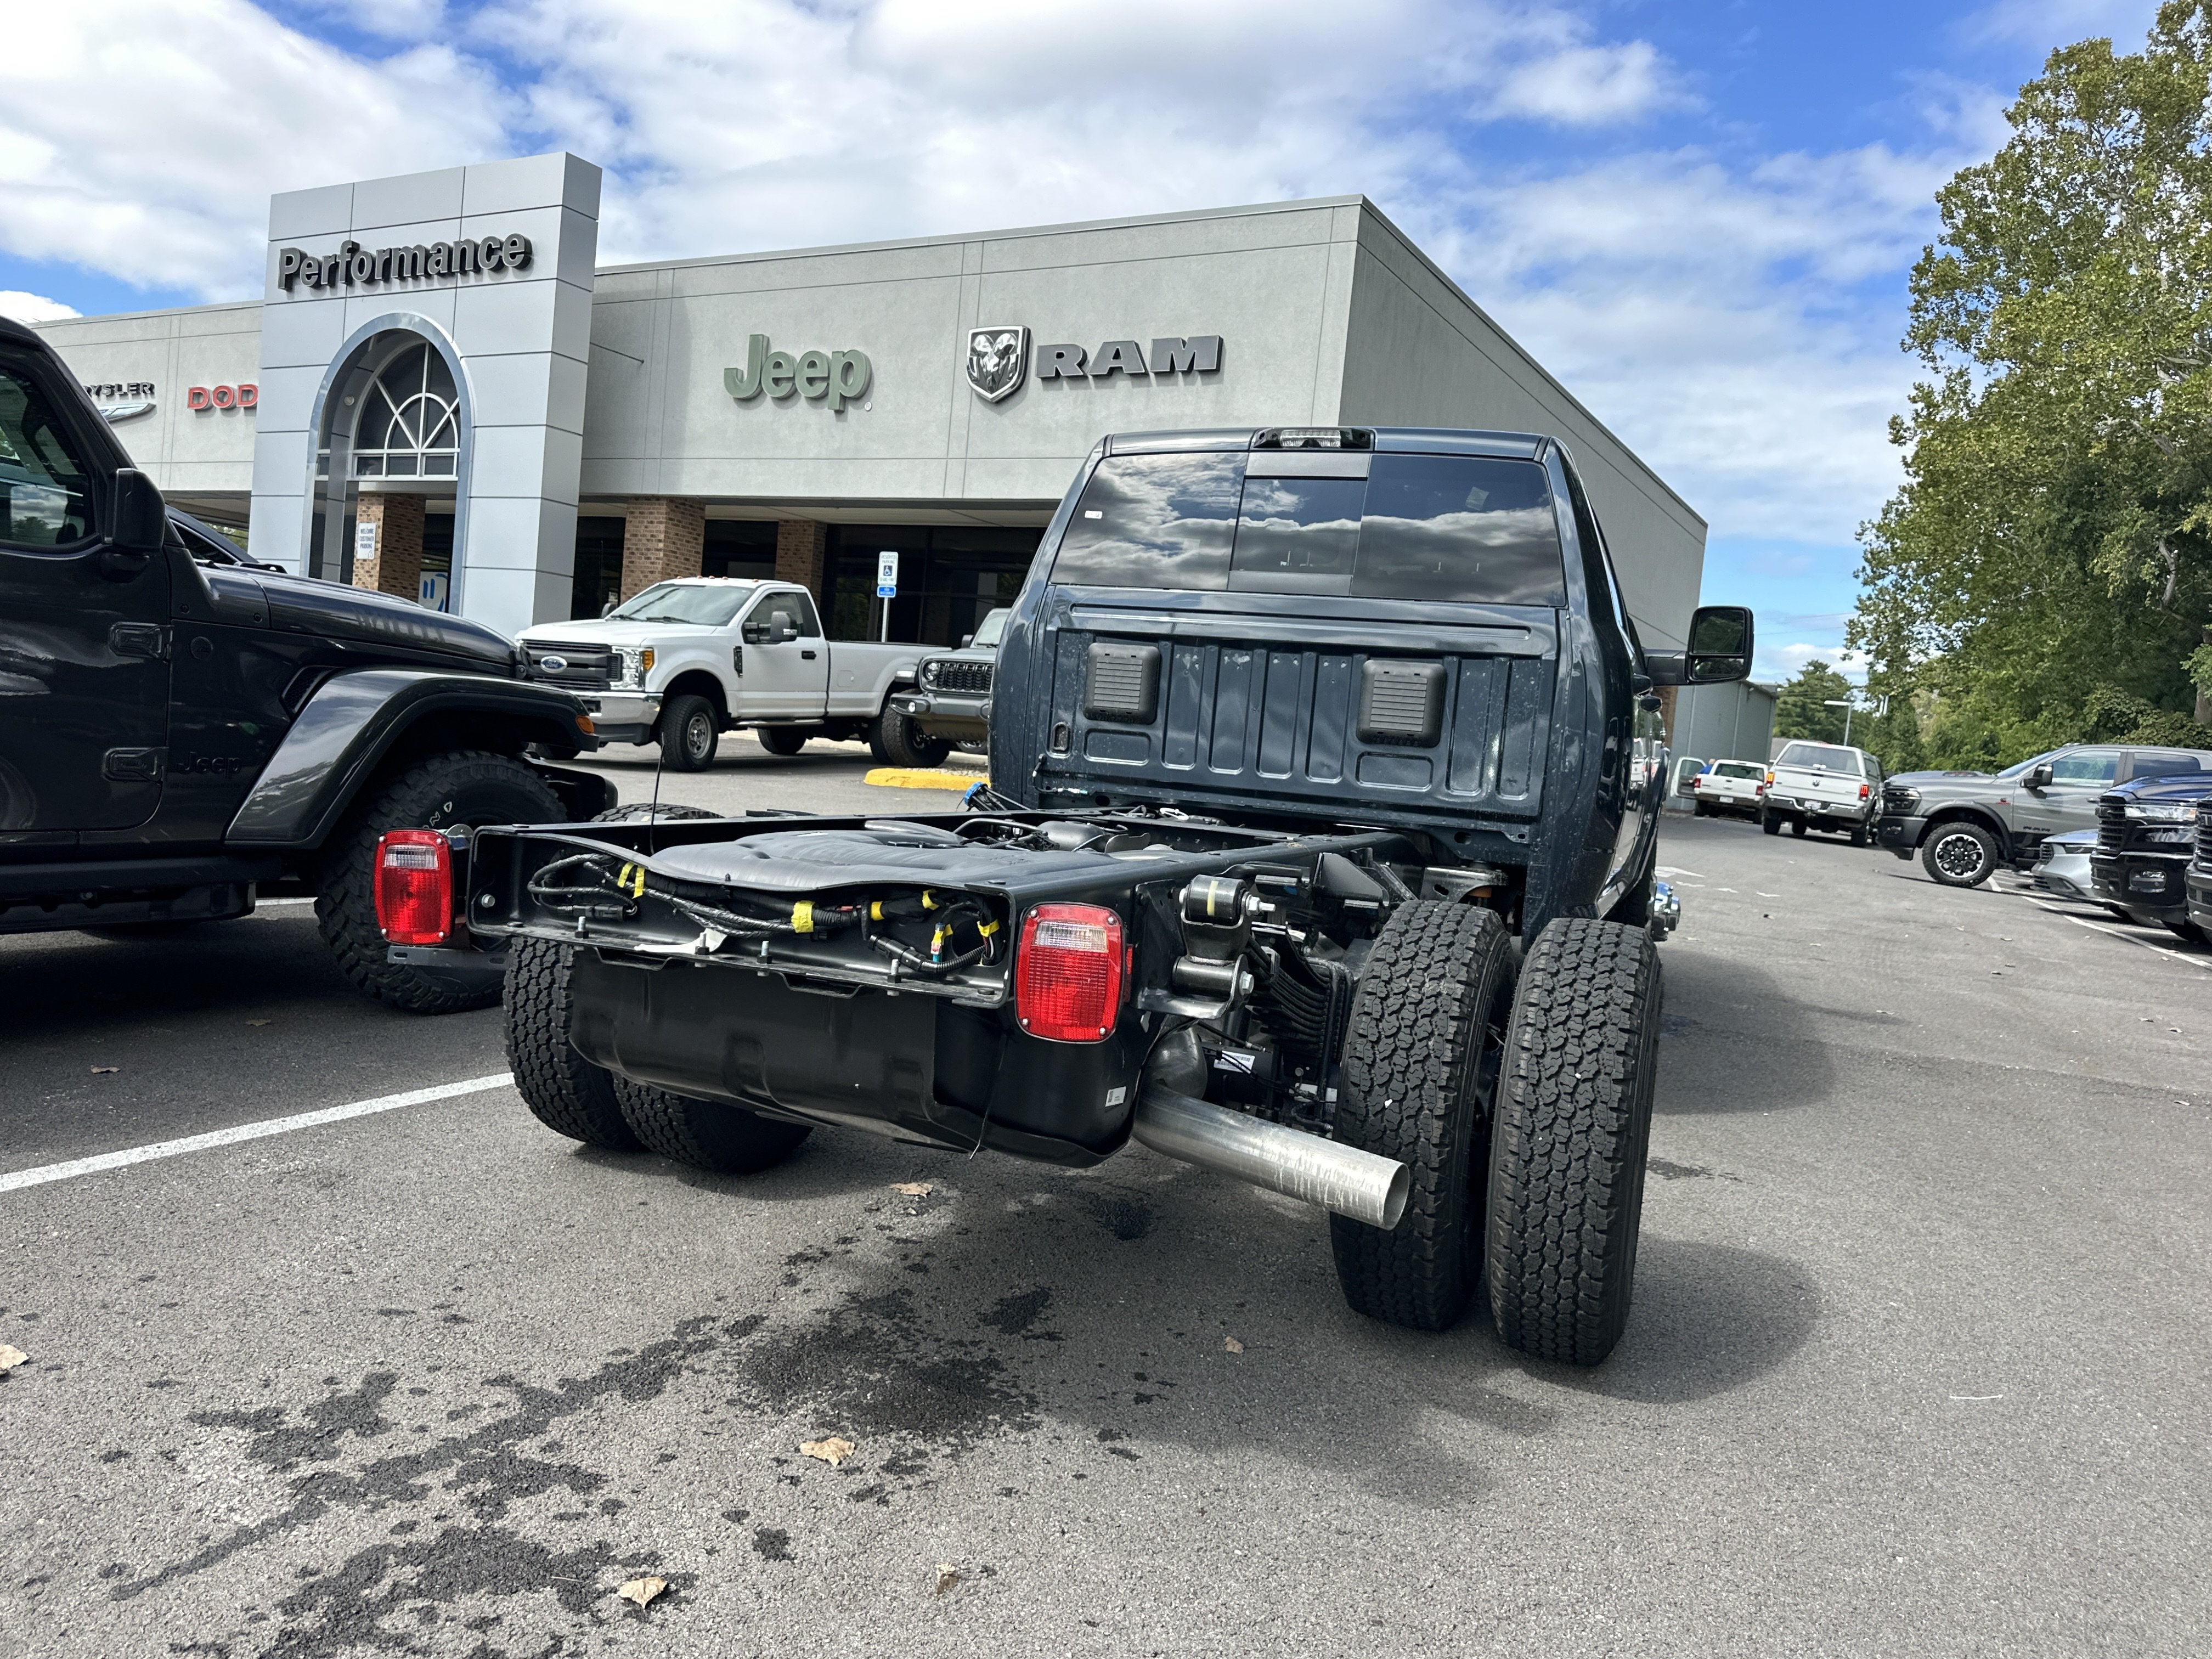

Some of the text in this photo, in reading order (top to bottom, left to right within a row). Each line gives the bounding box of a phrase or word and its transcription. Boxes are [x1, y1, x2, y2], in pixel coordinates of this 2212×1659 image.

[278, 233, 530, 290] Performance
[724, 333, 871, 413] Jeep
[1036, 335, 1223, 380] RAM
[176, 752, 241, 780] Jeep
